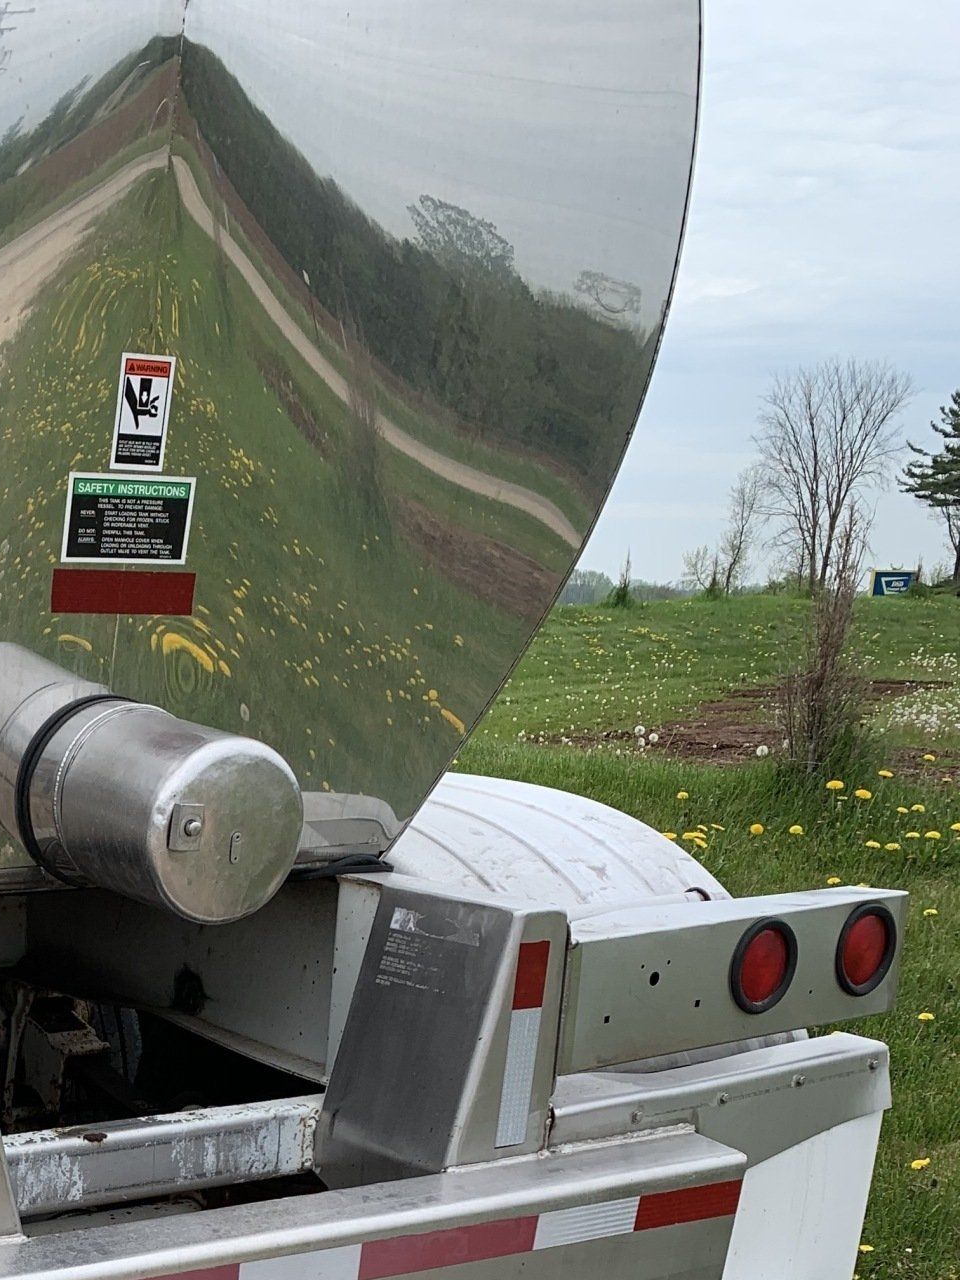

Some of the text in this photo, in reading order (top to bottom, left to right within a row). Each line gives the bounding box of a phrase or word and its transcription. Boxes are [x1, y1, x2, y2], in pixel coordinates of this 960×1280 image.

[135, 363, 168, 374] WARNING
[78, 482, 186, 497] SAFETY INSTRUCTIONS
